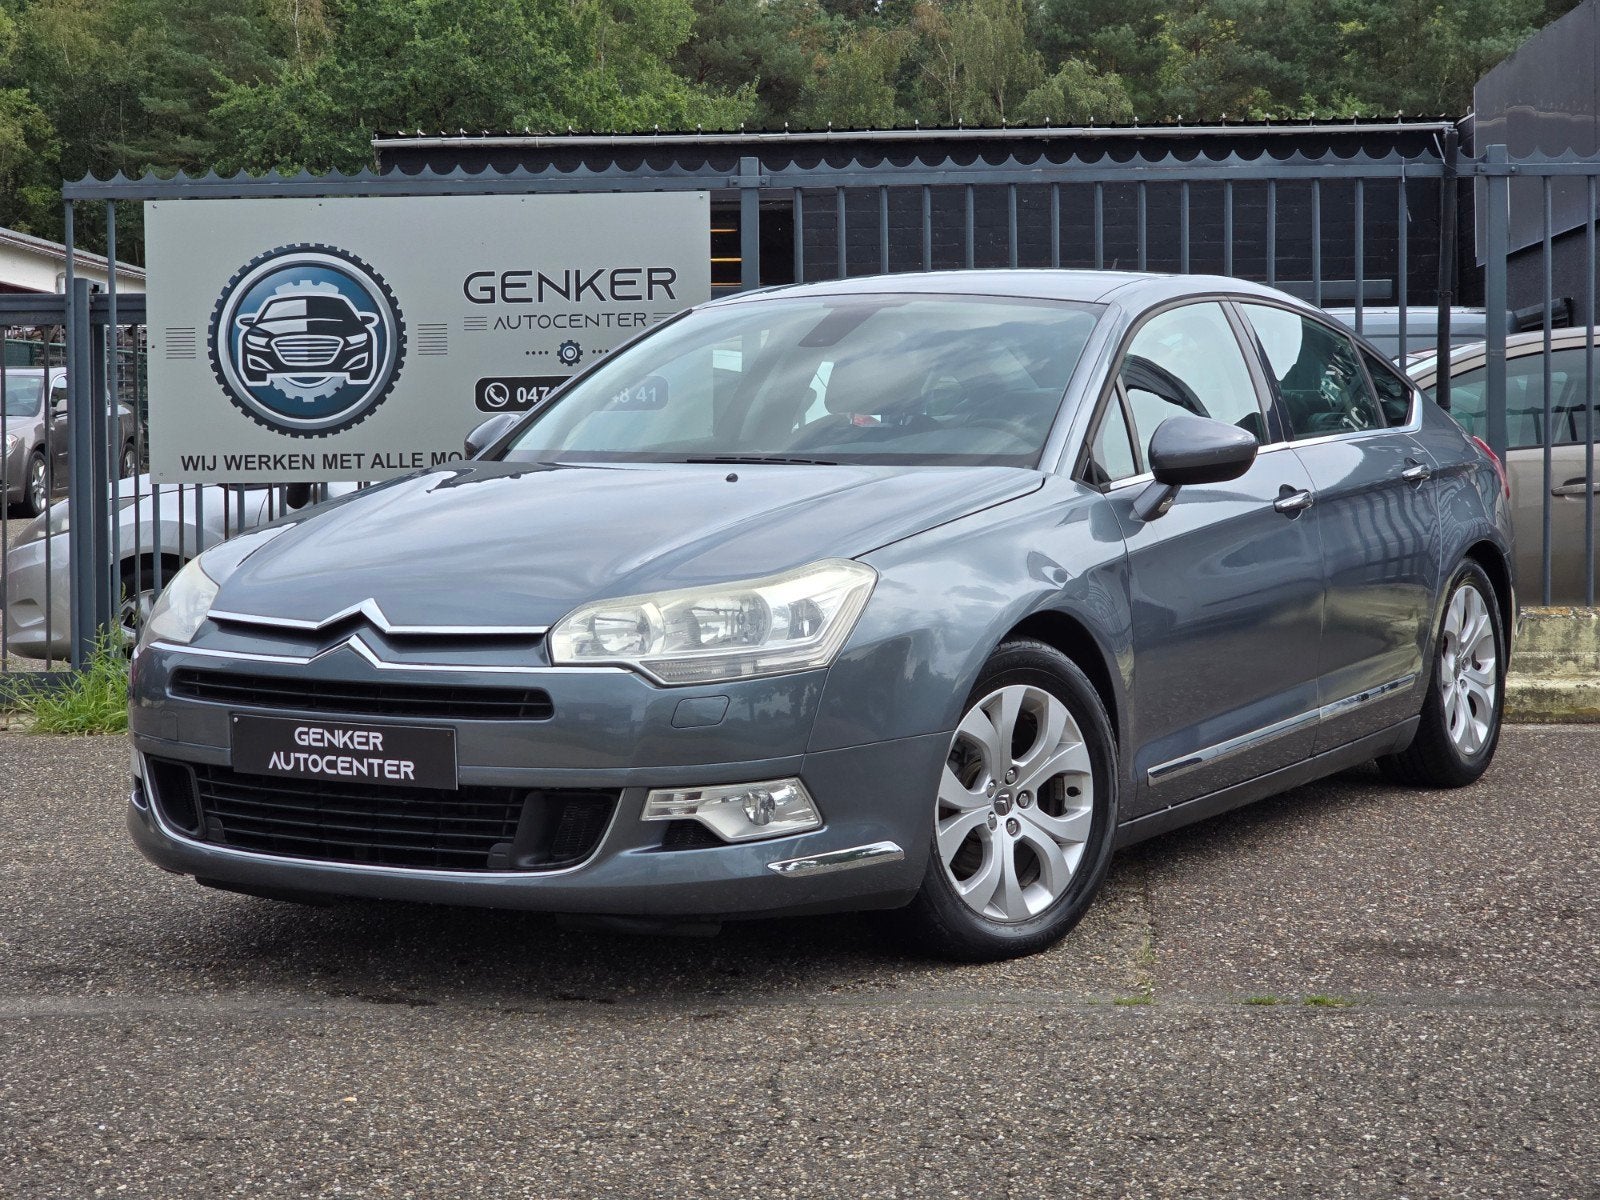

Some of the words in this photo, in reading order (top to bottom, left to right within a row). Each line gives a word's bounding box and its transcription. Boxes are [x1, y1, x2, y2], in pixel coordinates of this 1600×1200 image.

[463, 267, 677, 304] GENKER
[493, 312, 647, 330] AUTOCENTER
[516, 386, 557, 403] 047
[636, 386, 657, 402] 41
[180, 455, 217, 471] WIJ
[223, 453, 315, 471] WERKEN
[322, 453, 365, 470] MET
[370, 452, 424, 469] ALLE
[294, 726, 384, 752] GENKER
[268, 751, 415, 780] AUTOCENTER
